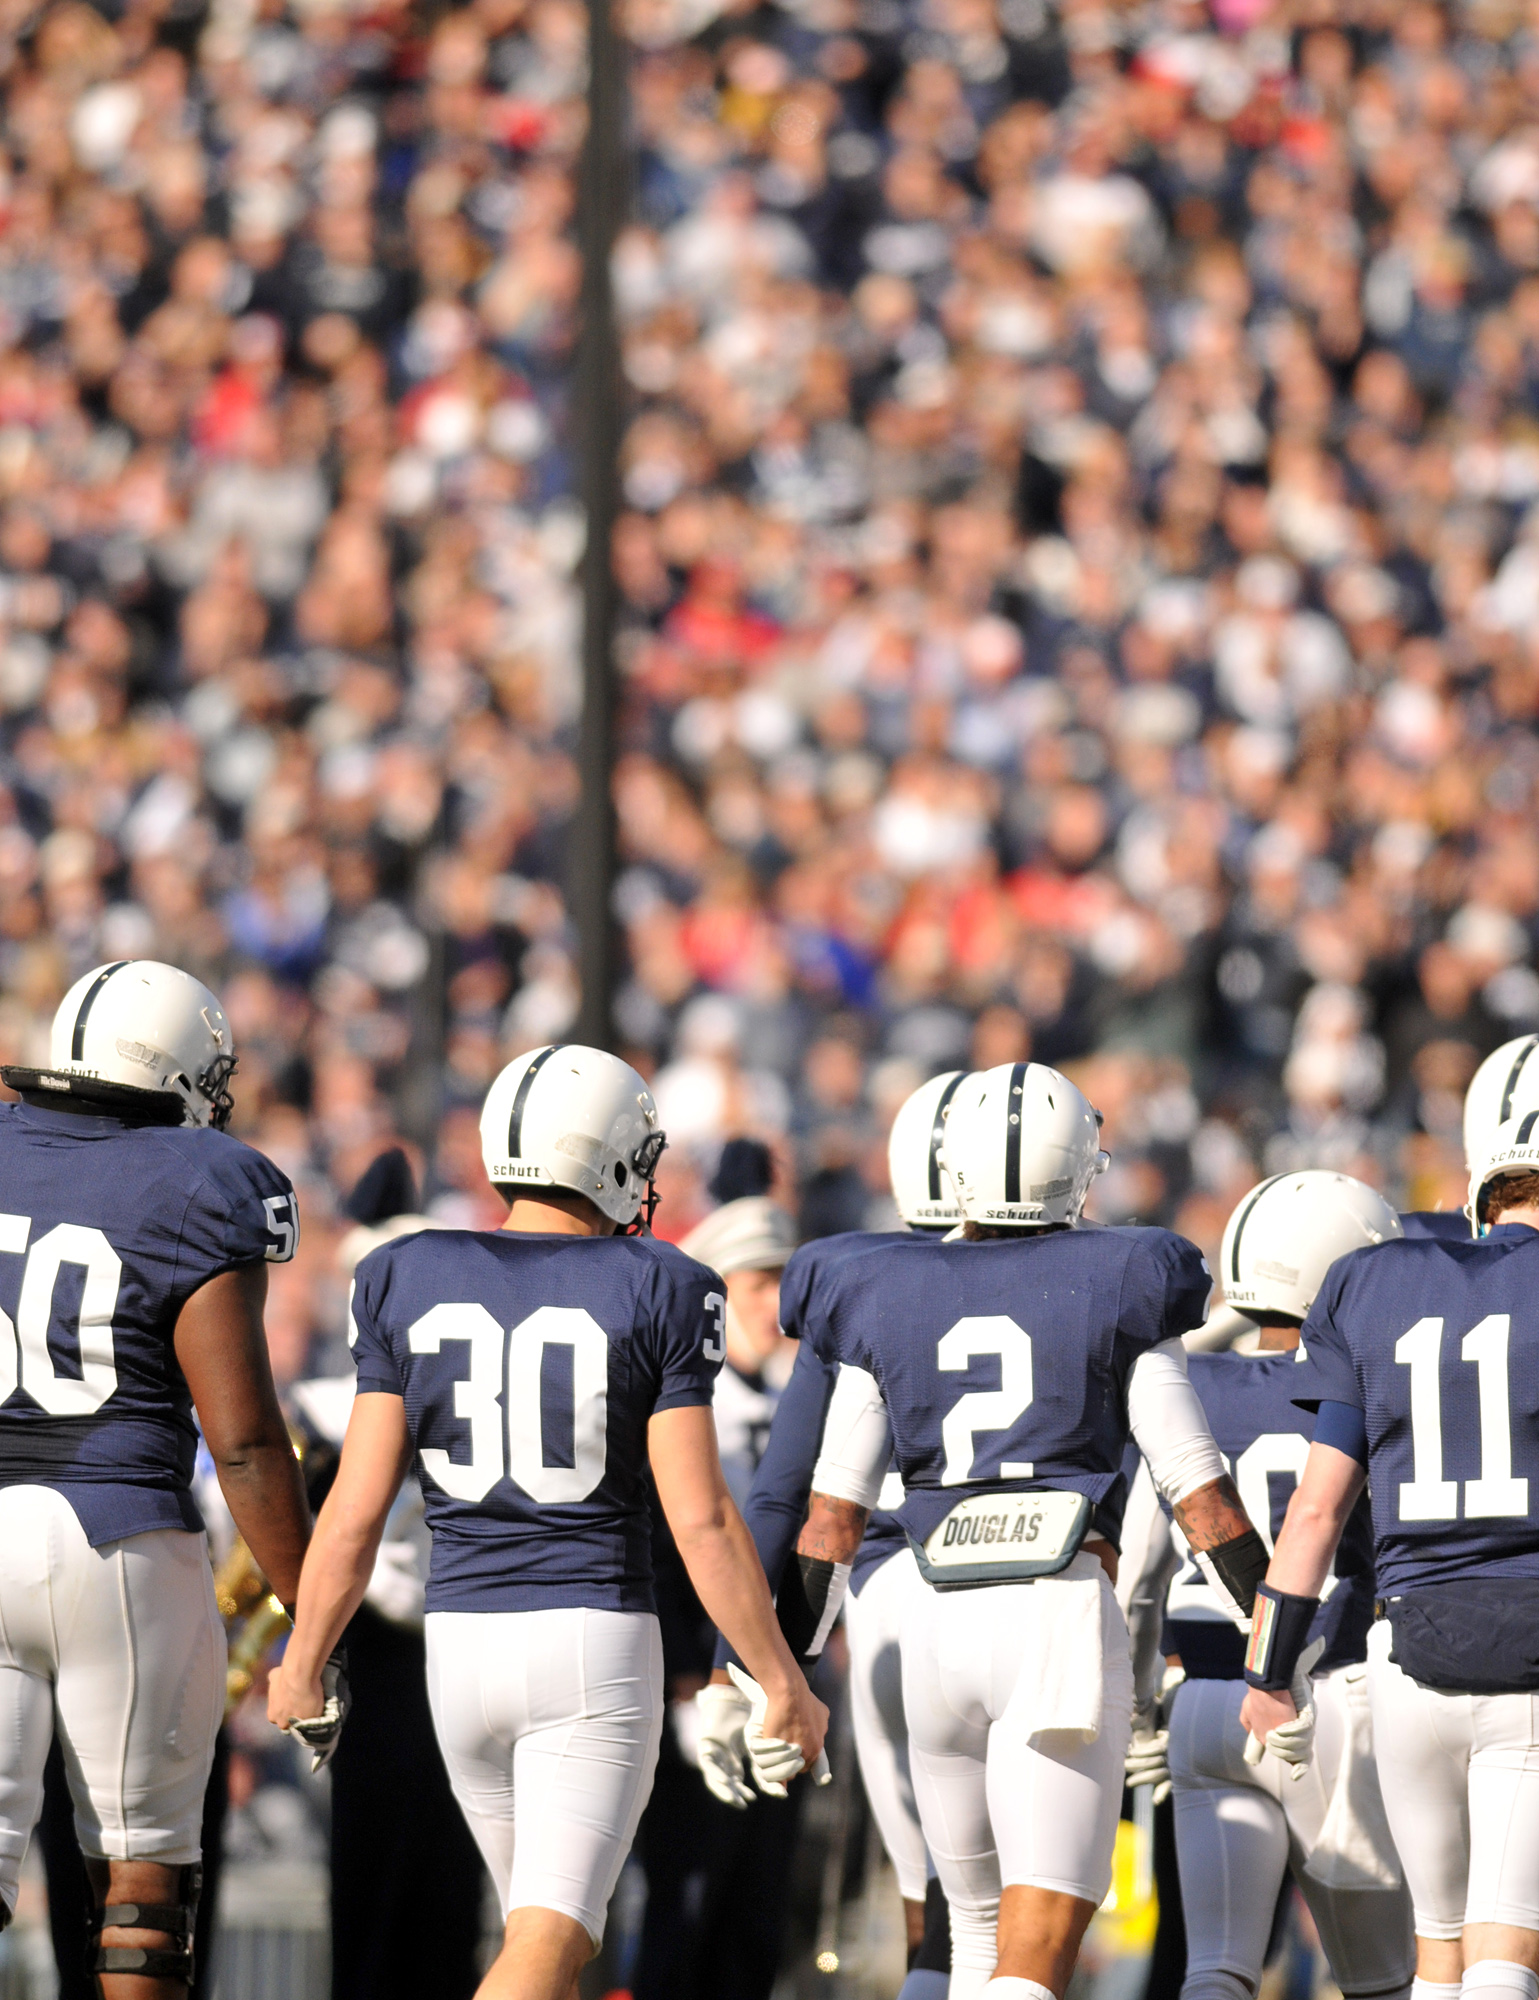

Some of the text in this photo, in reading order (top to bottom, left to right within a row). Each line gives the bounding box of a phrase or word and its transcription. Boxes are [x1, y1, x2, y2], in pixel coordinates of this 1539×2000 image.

[58, 1066, 99, 1078] hutt
[493, 1163, 540, 1178] schutt
[916, 1206, 961, 1218] schut
[986, 1206, 1043, 1219] schutt
[0, 1213, 123, 1415] 0
[408, 1303, 608, 1503] 30
[938, 1315, 1033, 1487] 2
[1394, 1313, 1528, 1521] 11
[942, 1513, 1043, 1547] DOUGLAS
